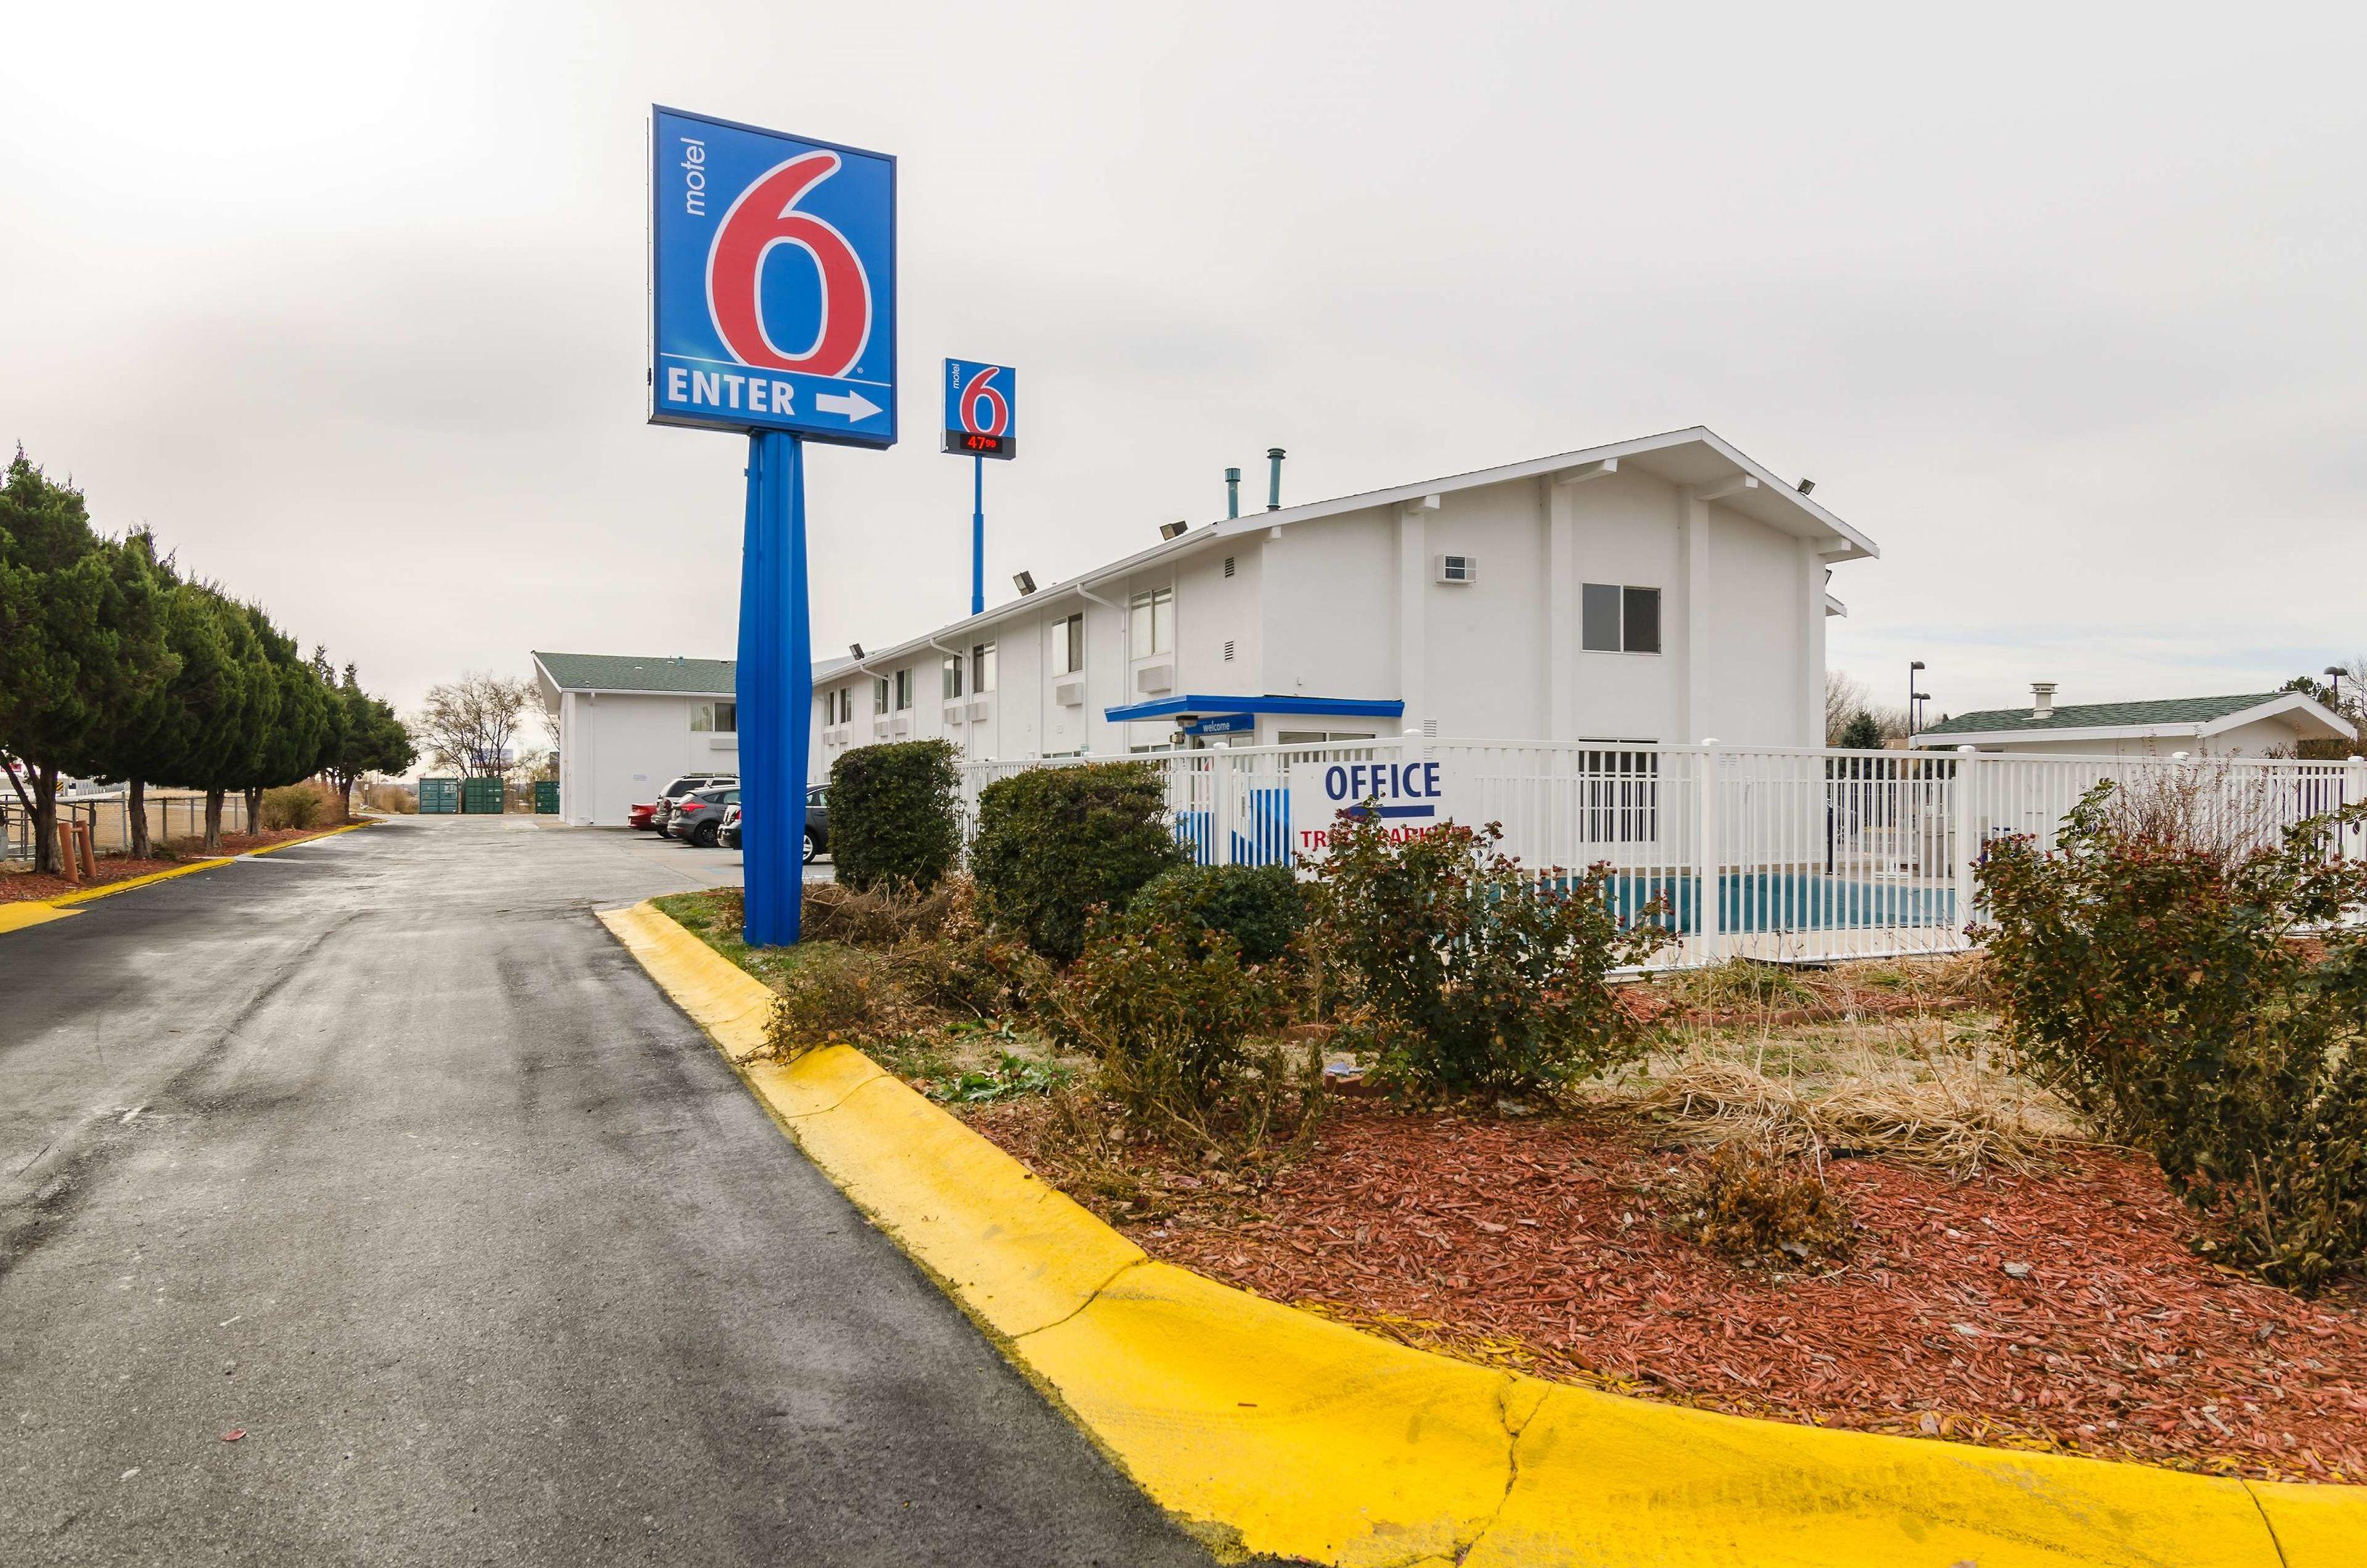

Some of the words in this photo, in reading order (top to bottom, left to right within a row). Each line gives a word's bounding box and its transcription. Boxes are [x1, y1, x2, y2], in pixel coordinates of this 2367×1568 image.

[680, 137, 706, 216] motel
[706, 150, 872, 378] 6
[669, 367, 796, 416] ENTER
[960, 367, 1009, 437] 6
[1203, 720, 1230, 732] welcome
[1325, 762, 1442, 801] OFFICE
